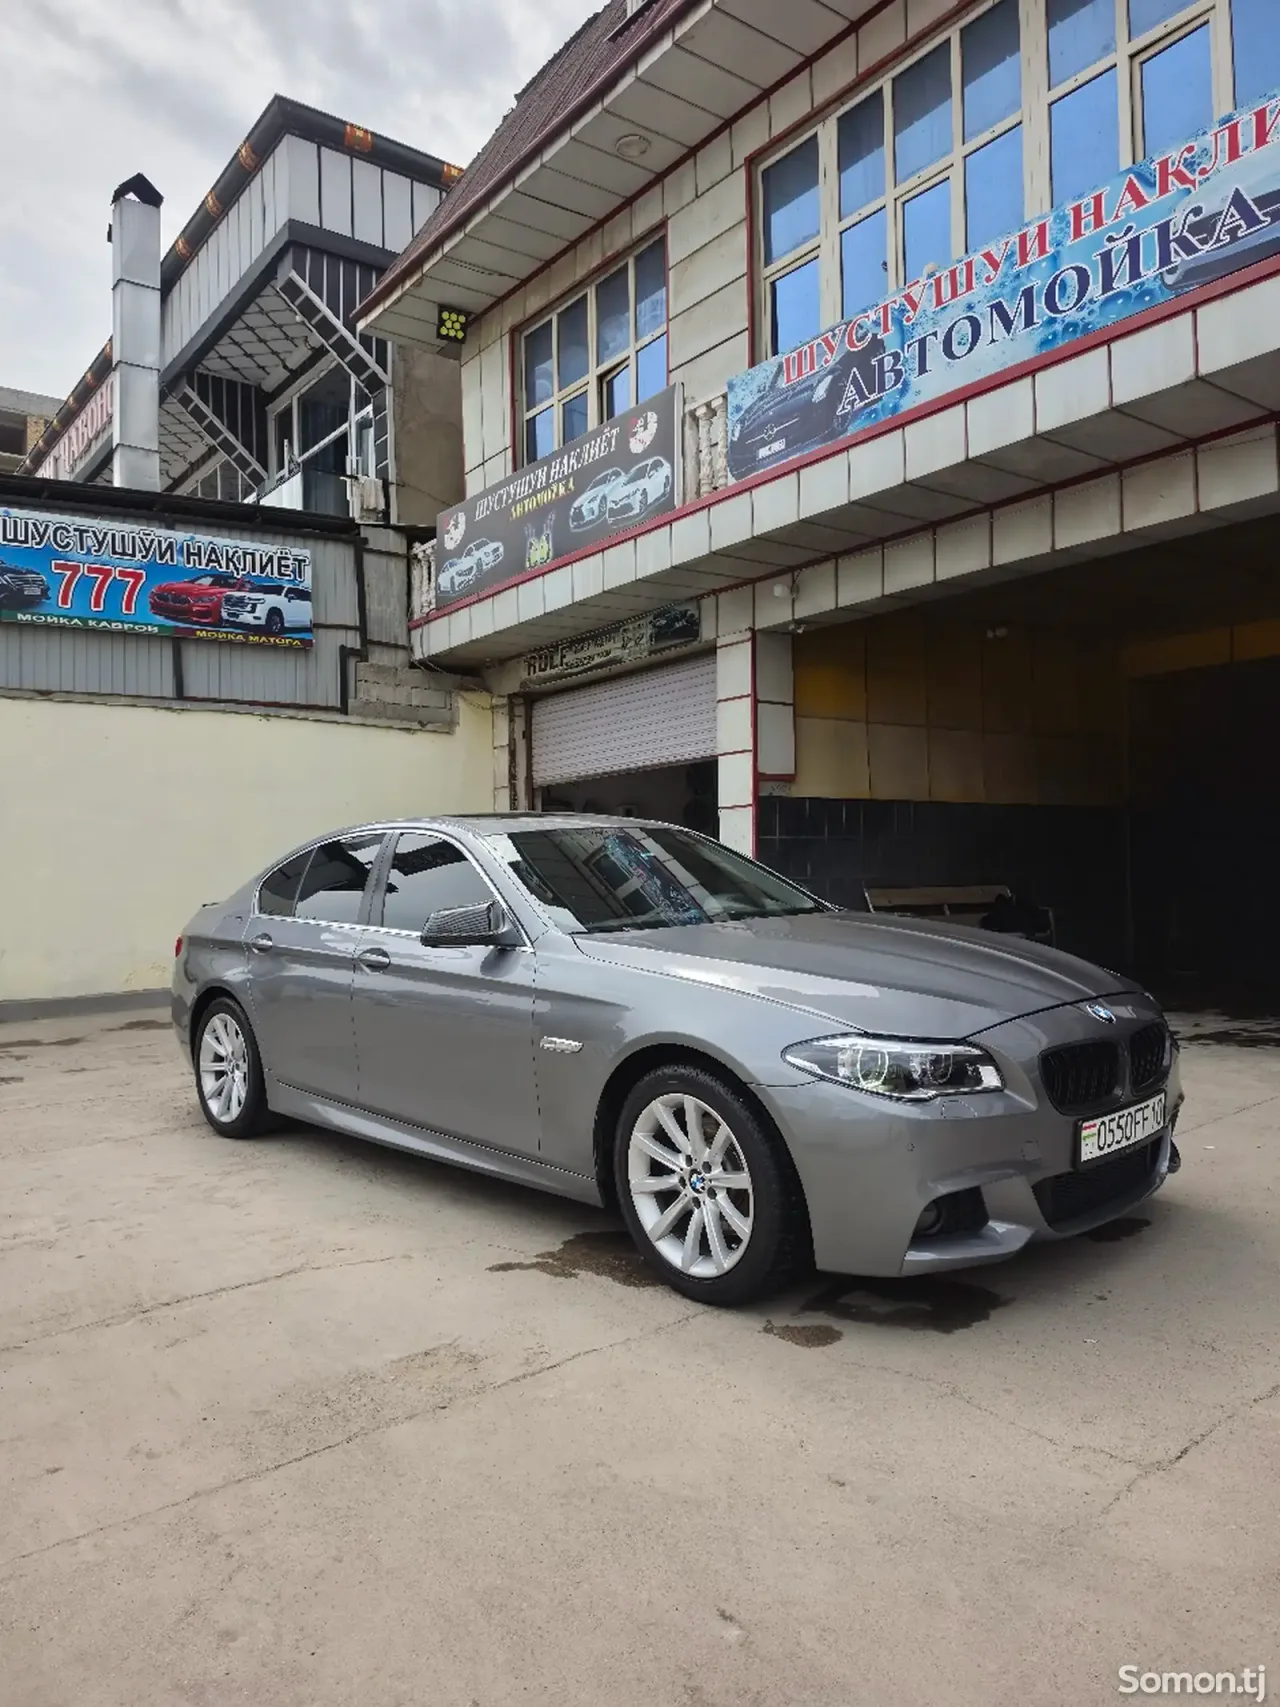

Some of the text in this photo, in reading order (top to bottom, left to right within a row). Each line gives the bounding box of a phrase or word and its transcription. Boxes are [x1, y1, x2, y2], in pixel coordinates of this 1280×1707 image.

[836, 185, 1272, 416] АВТОМОЙКА
[183, 540, 310, 582] НАҚЛИЁТ
[51, 560, 146, 615] 777
[17, 613, 83, 626] МОЙКА
